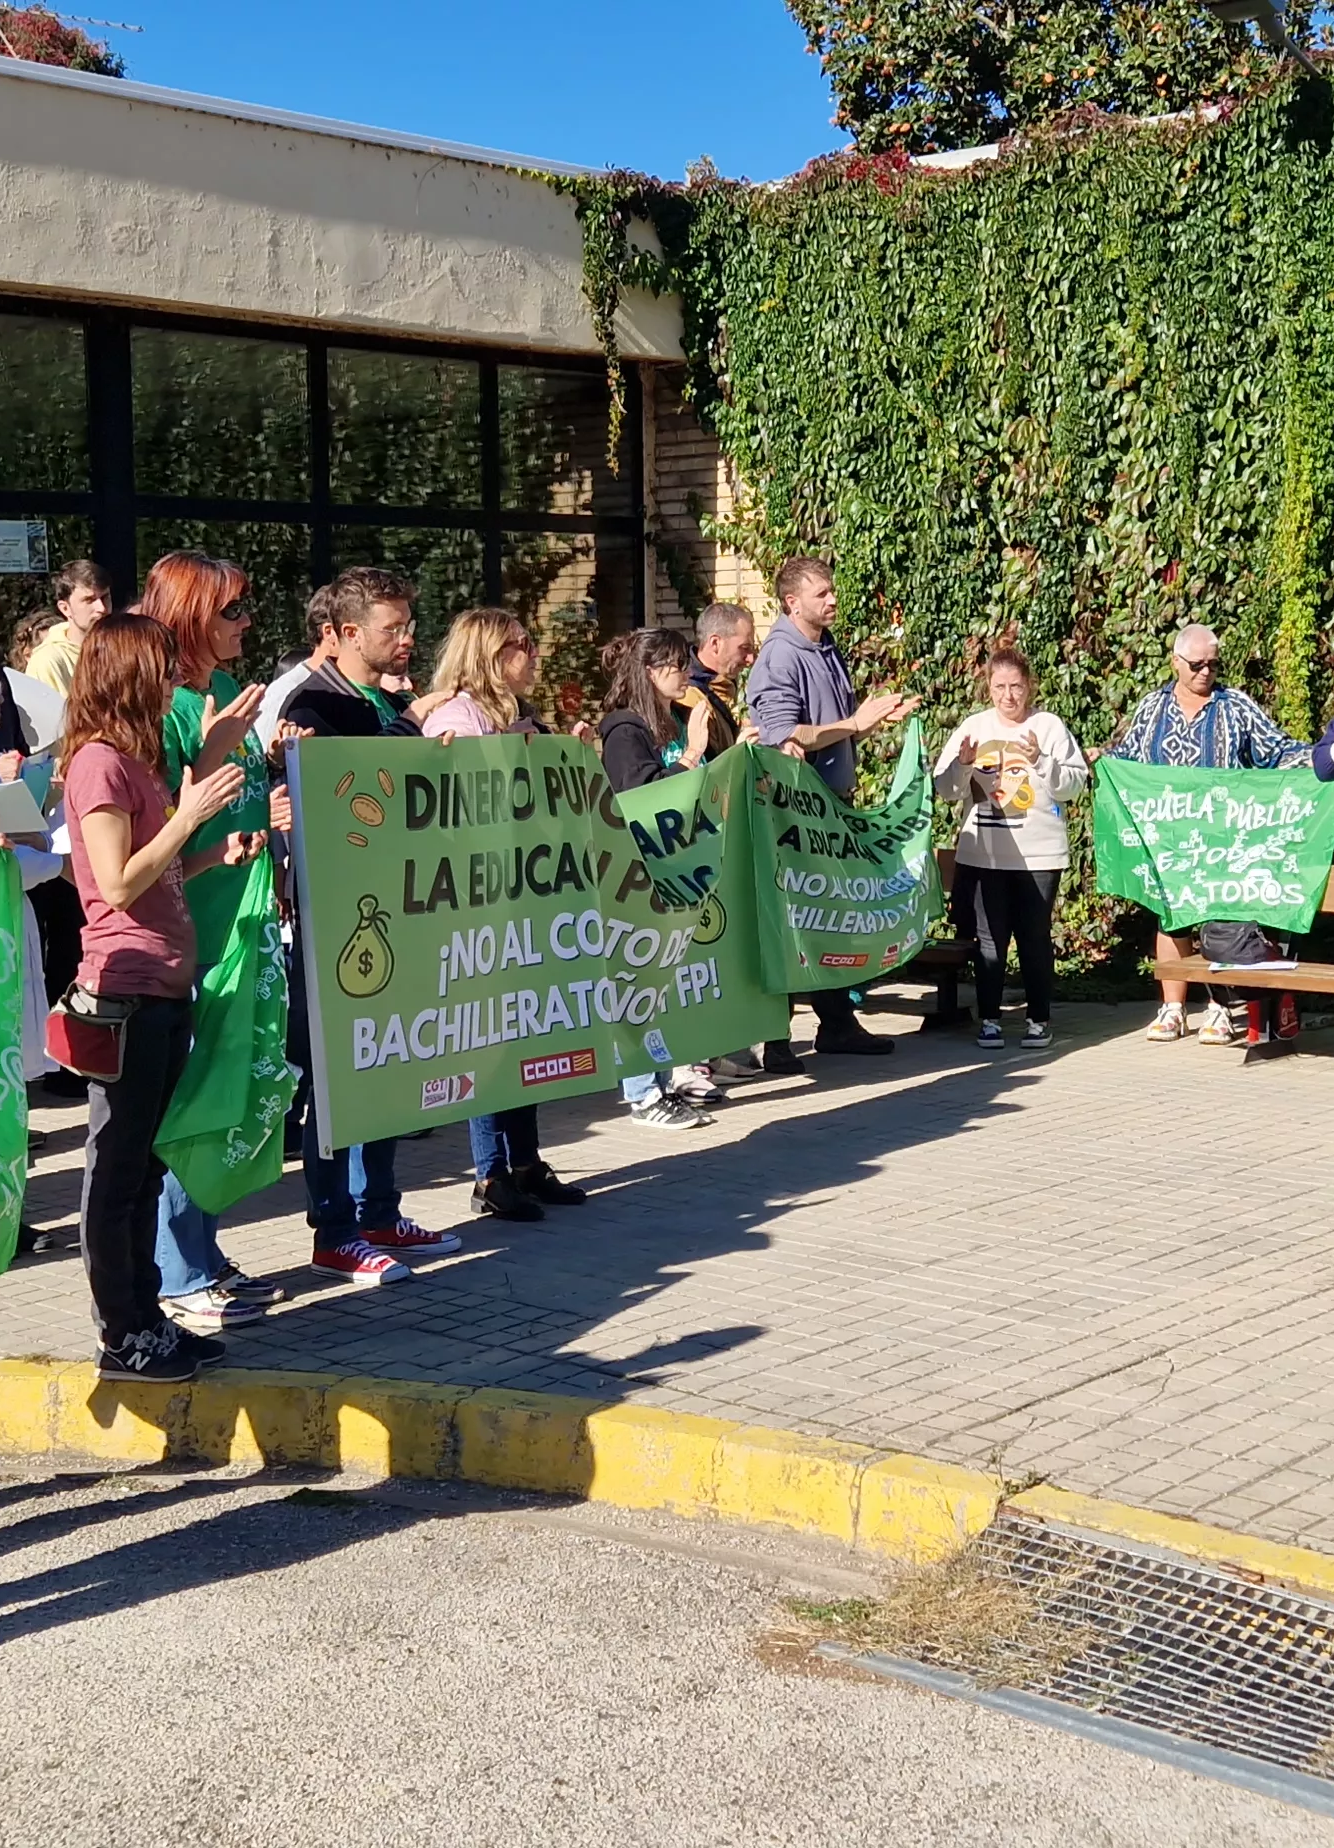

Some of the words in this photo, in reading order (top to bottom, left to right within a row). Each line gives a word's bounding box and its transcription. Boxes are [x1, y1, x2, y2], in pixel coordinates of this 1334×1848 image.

[404, 766, 535, 831] DINERO
[629, 798, 720, 861] ARA
[777, 824, 801, 852] A
[1157, 850, 1174, 873] E
[403, 856, 459, 915] LA
[439, 925, 496, 997] ¡NO
[500, 917, 543, 971] AL
[353, 976, 613, 1071] BACHILLERATO
[675, 956, 721, 1008] FP!
[425, 1078, 447, 1094] CGT
[524, 1057, 571, 1081] CCOO
